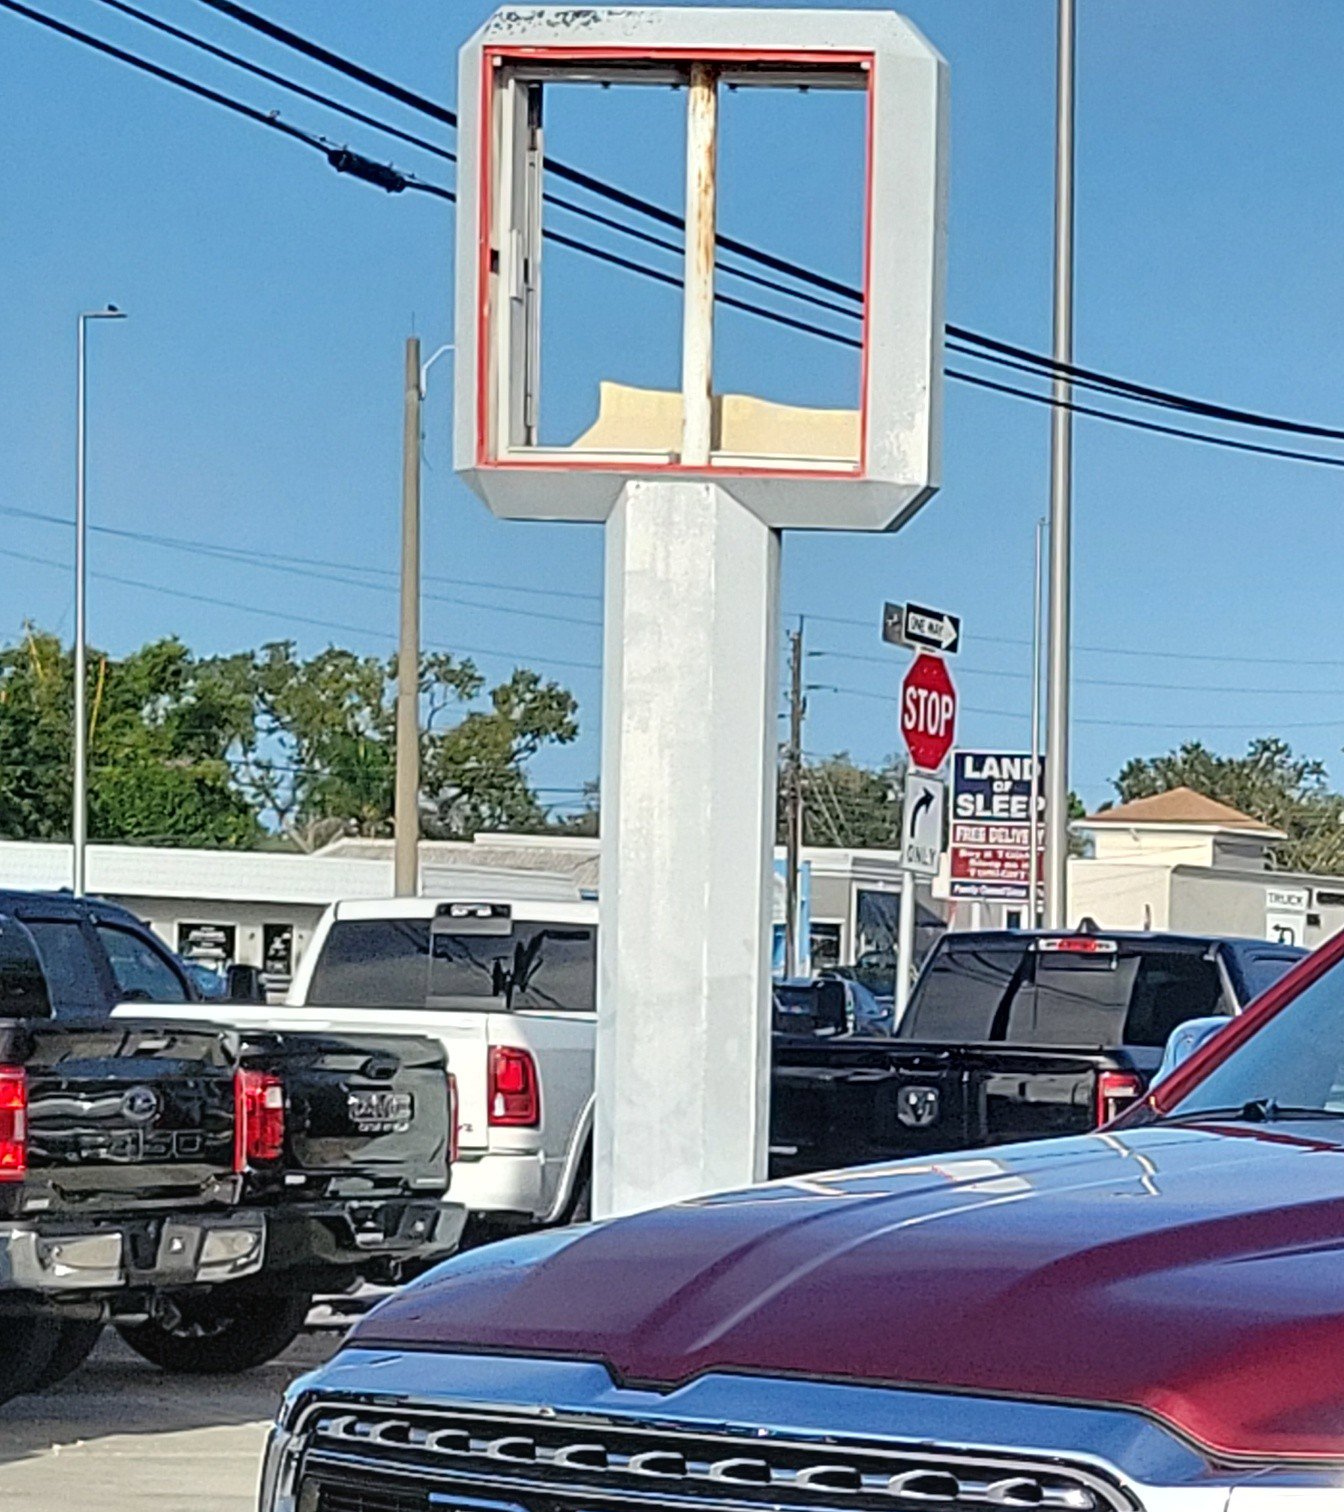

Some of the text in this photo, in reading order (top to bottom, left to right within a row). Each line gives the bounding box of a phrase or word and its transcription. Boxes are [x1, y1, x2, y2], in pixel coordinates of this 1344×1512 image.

[911, 615, 926, 634] ONE
[903, 685, 953, 737] STOP
[964, 756, 1042, 780] LAND
[993, 781, 1013, 793] OF
[955, 825, 1045, 846] FREE DELIVEY
[906, 844, 936, 866] ONLY
[1267, 892, 1304, 906] TRUCK
